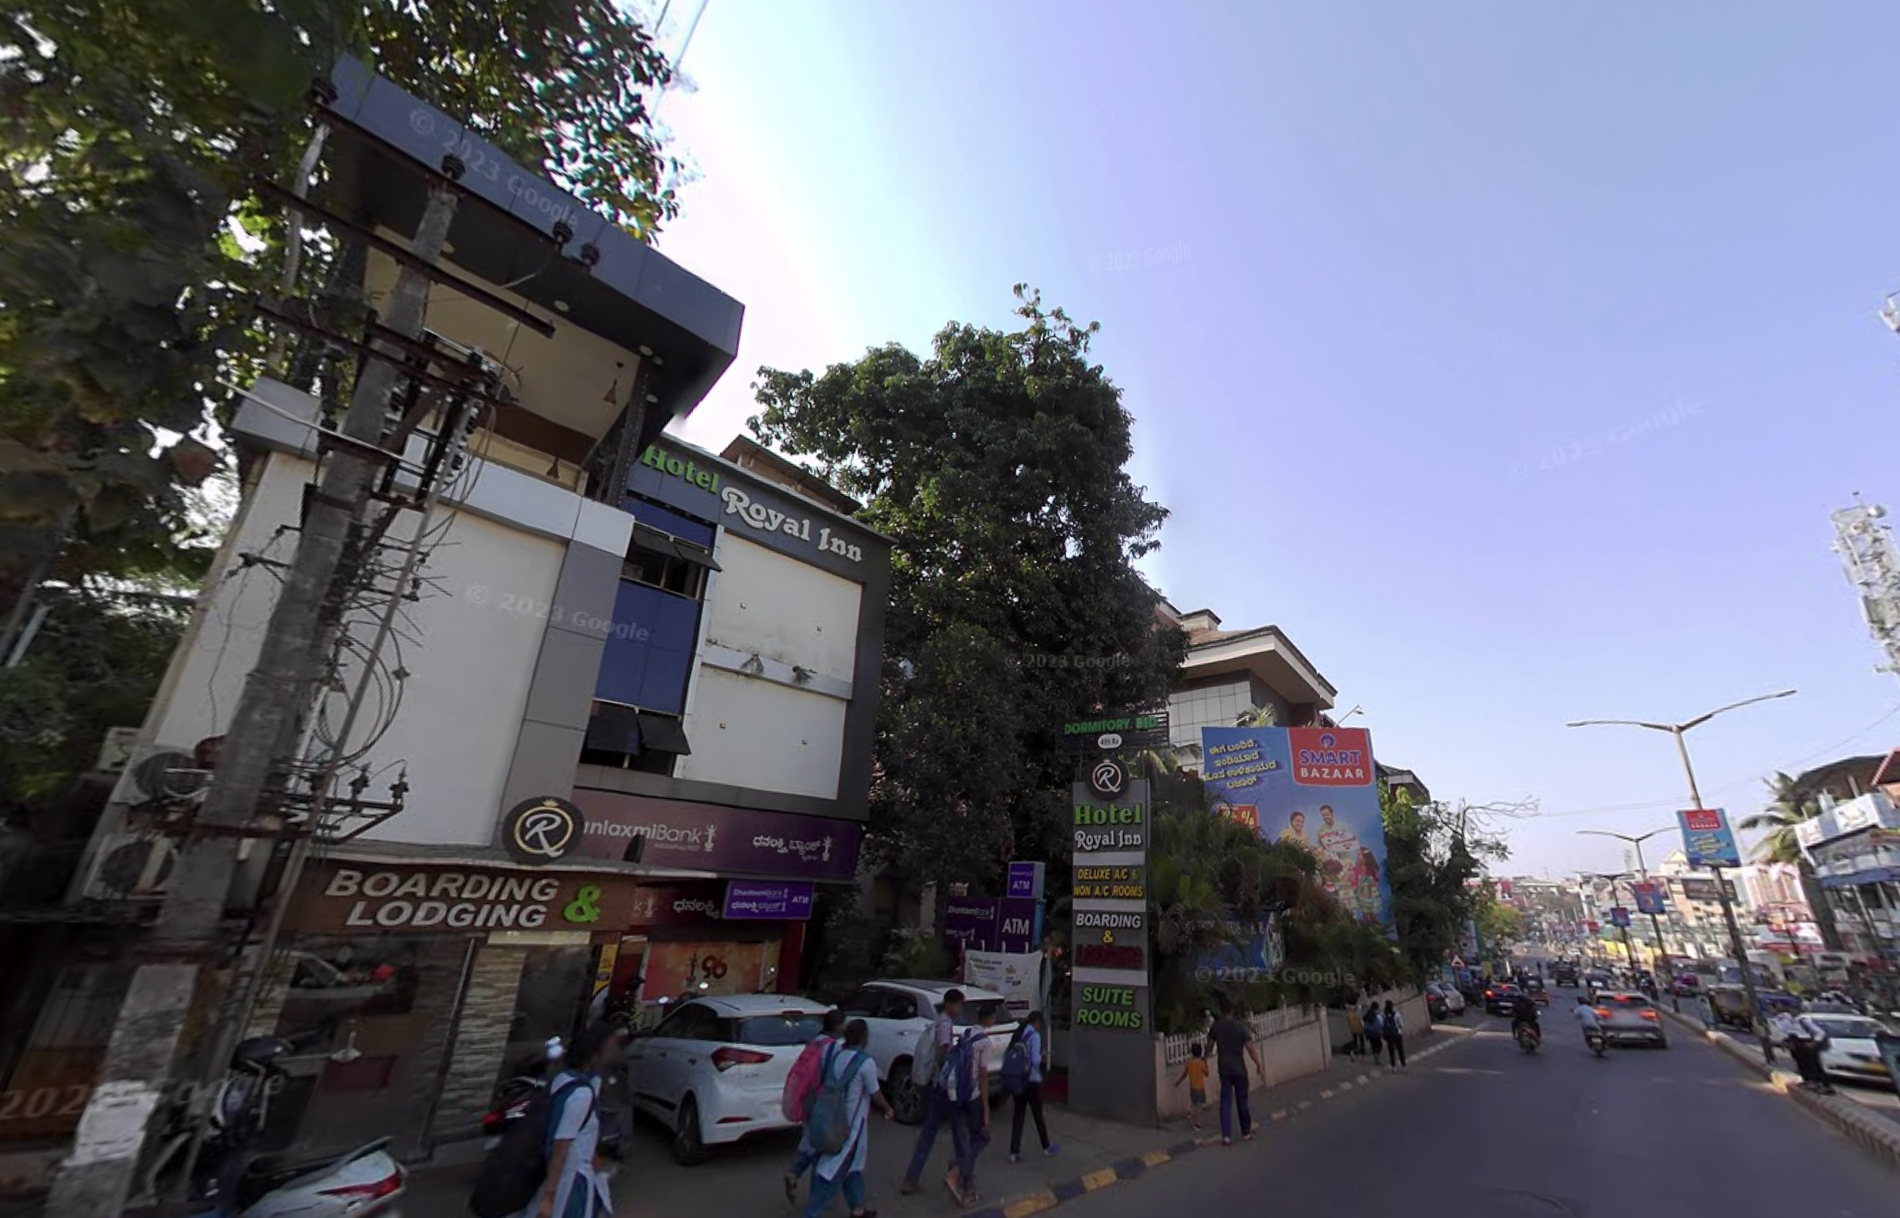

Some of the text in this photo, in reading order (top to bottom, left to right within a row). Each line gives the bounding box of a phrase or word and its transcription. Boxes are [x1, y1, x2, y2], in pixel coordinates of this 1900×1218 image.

[640, 444, 862, 563] Hotel Royal Inn
[1064, 716, 1158, 735] DORMITORY BED
[1299, 749, 1361, 766] SMART
[1300, 767, 1364, 779] BAZAAR
[1074, 803, 1142, 826] Hotel
[1074, 830, 1143, 851] Royal Inn
[1077, 868, 1111, 880] DELUXE
[324, 869, 561, 903] BOARDING
[1011, 880, 1031, 891] ATM
[1074, 884, 1091, 897] NON
[1112, 885, 1144, 898] ROOMS
[564, 884, 602, 923] &
[791, 895, 810, 904] ATM
[346, 899, 548, 929] LODGING
[1076, 913, 1142, 929] BOARDING
[1001, 917, 1030, 935] ATM
[1102, 928, 1114, 945] &
[1082, 986, 1134, 1006] SUITE
[1076, 1009, 1142, 1029] ROOMS
